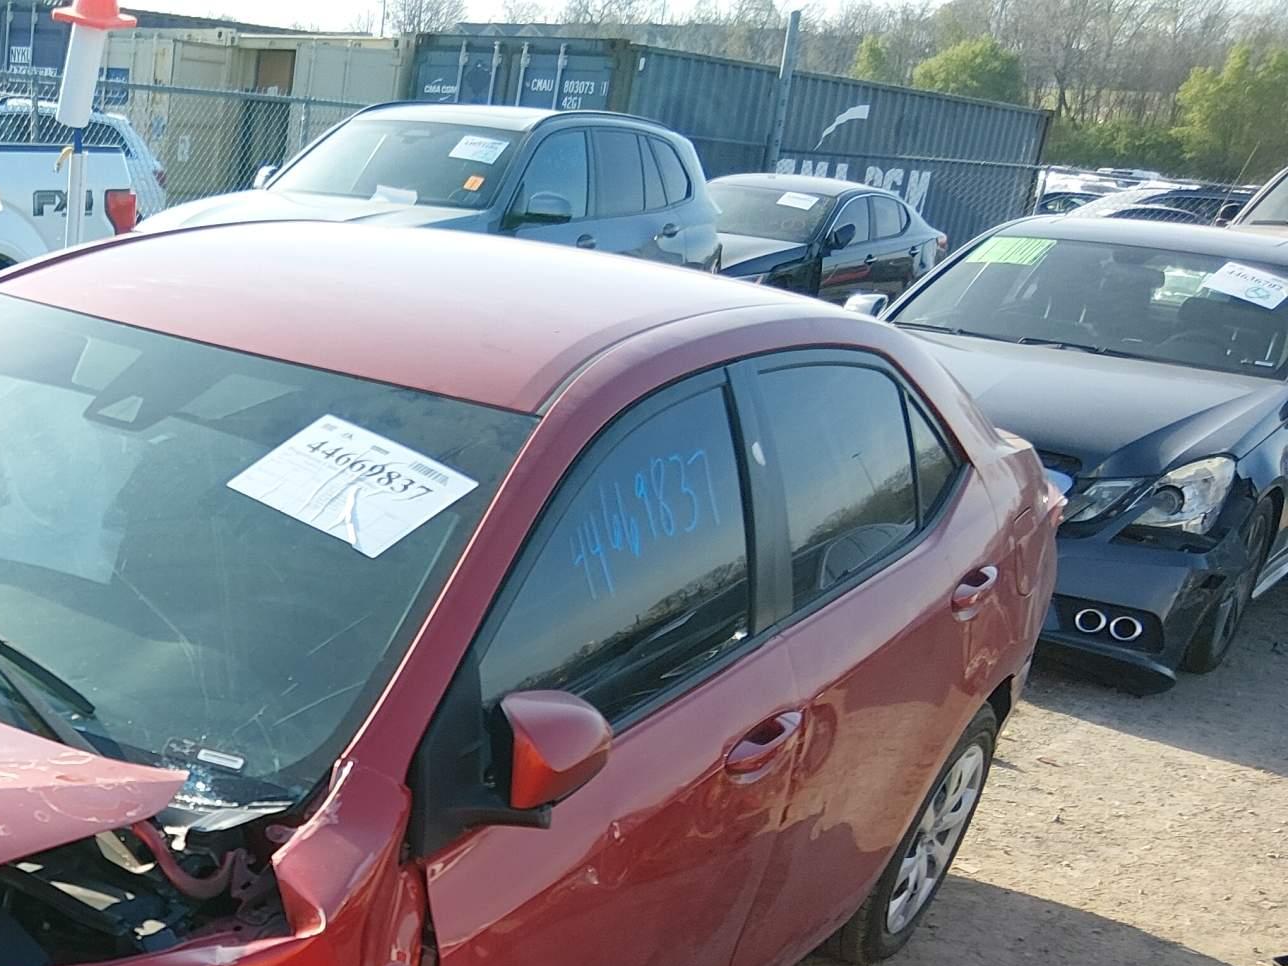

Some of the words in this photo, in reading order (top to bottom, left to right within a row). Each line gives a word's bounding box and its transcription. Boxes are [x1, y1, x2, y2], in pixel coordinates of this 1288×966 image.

[531, 79, 554, 91] CMAU
[563, 80, 595, 95] 803073
[562, 96, 582, 110] 42G1
[307, 440, 434, 502] 44669837
[569, 449, 720, 600] 44669837
